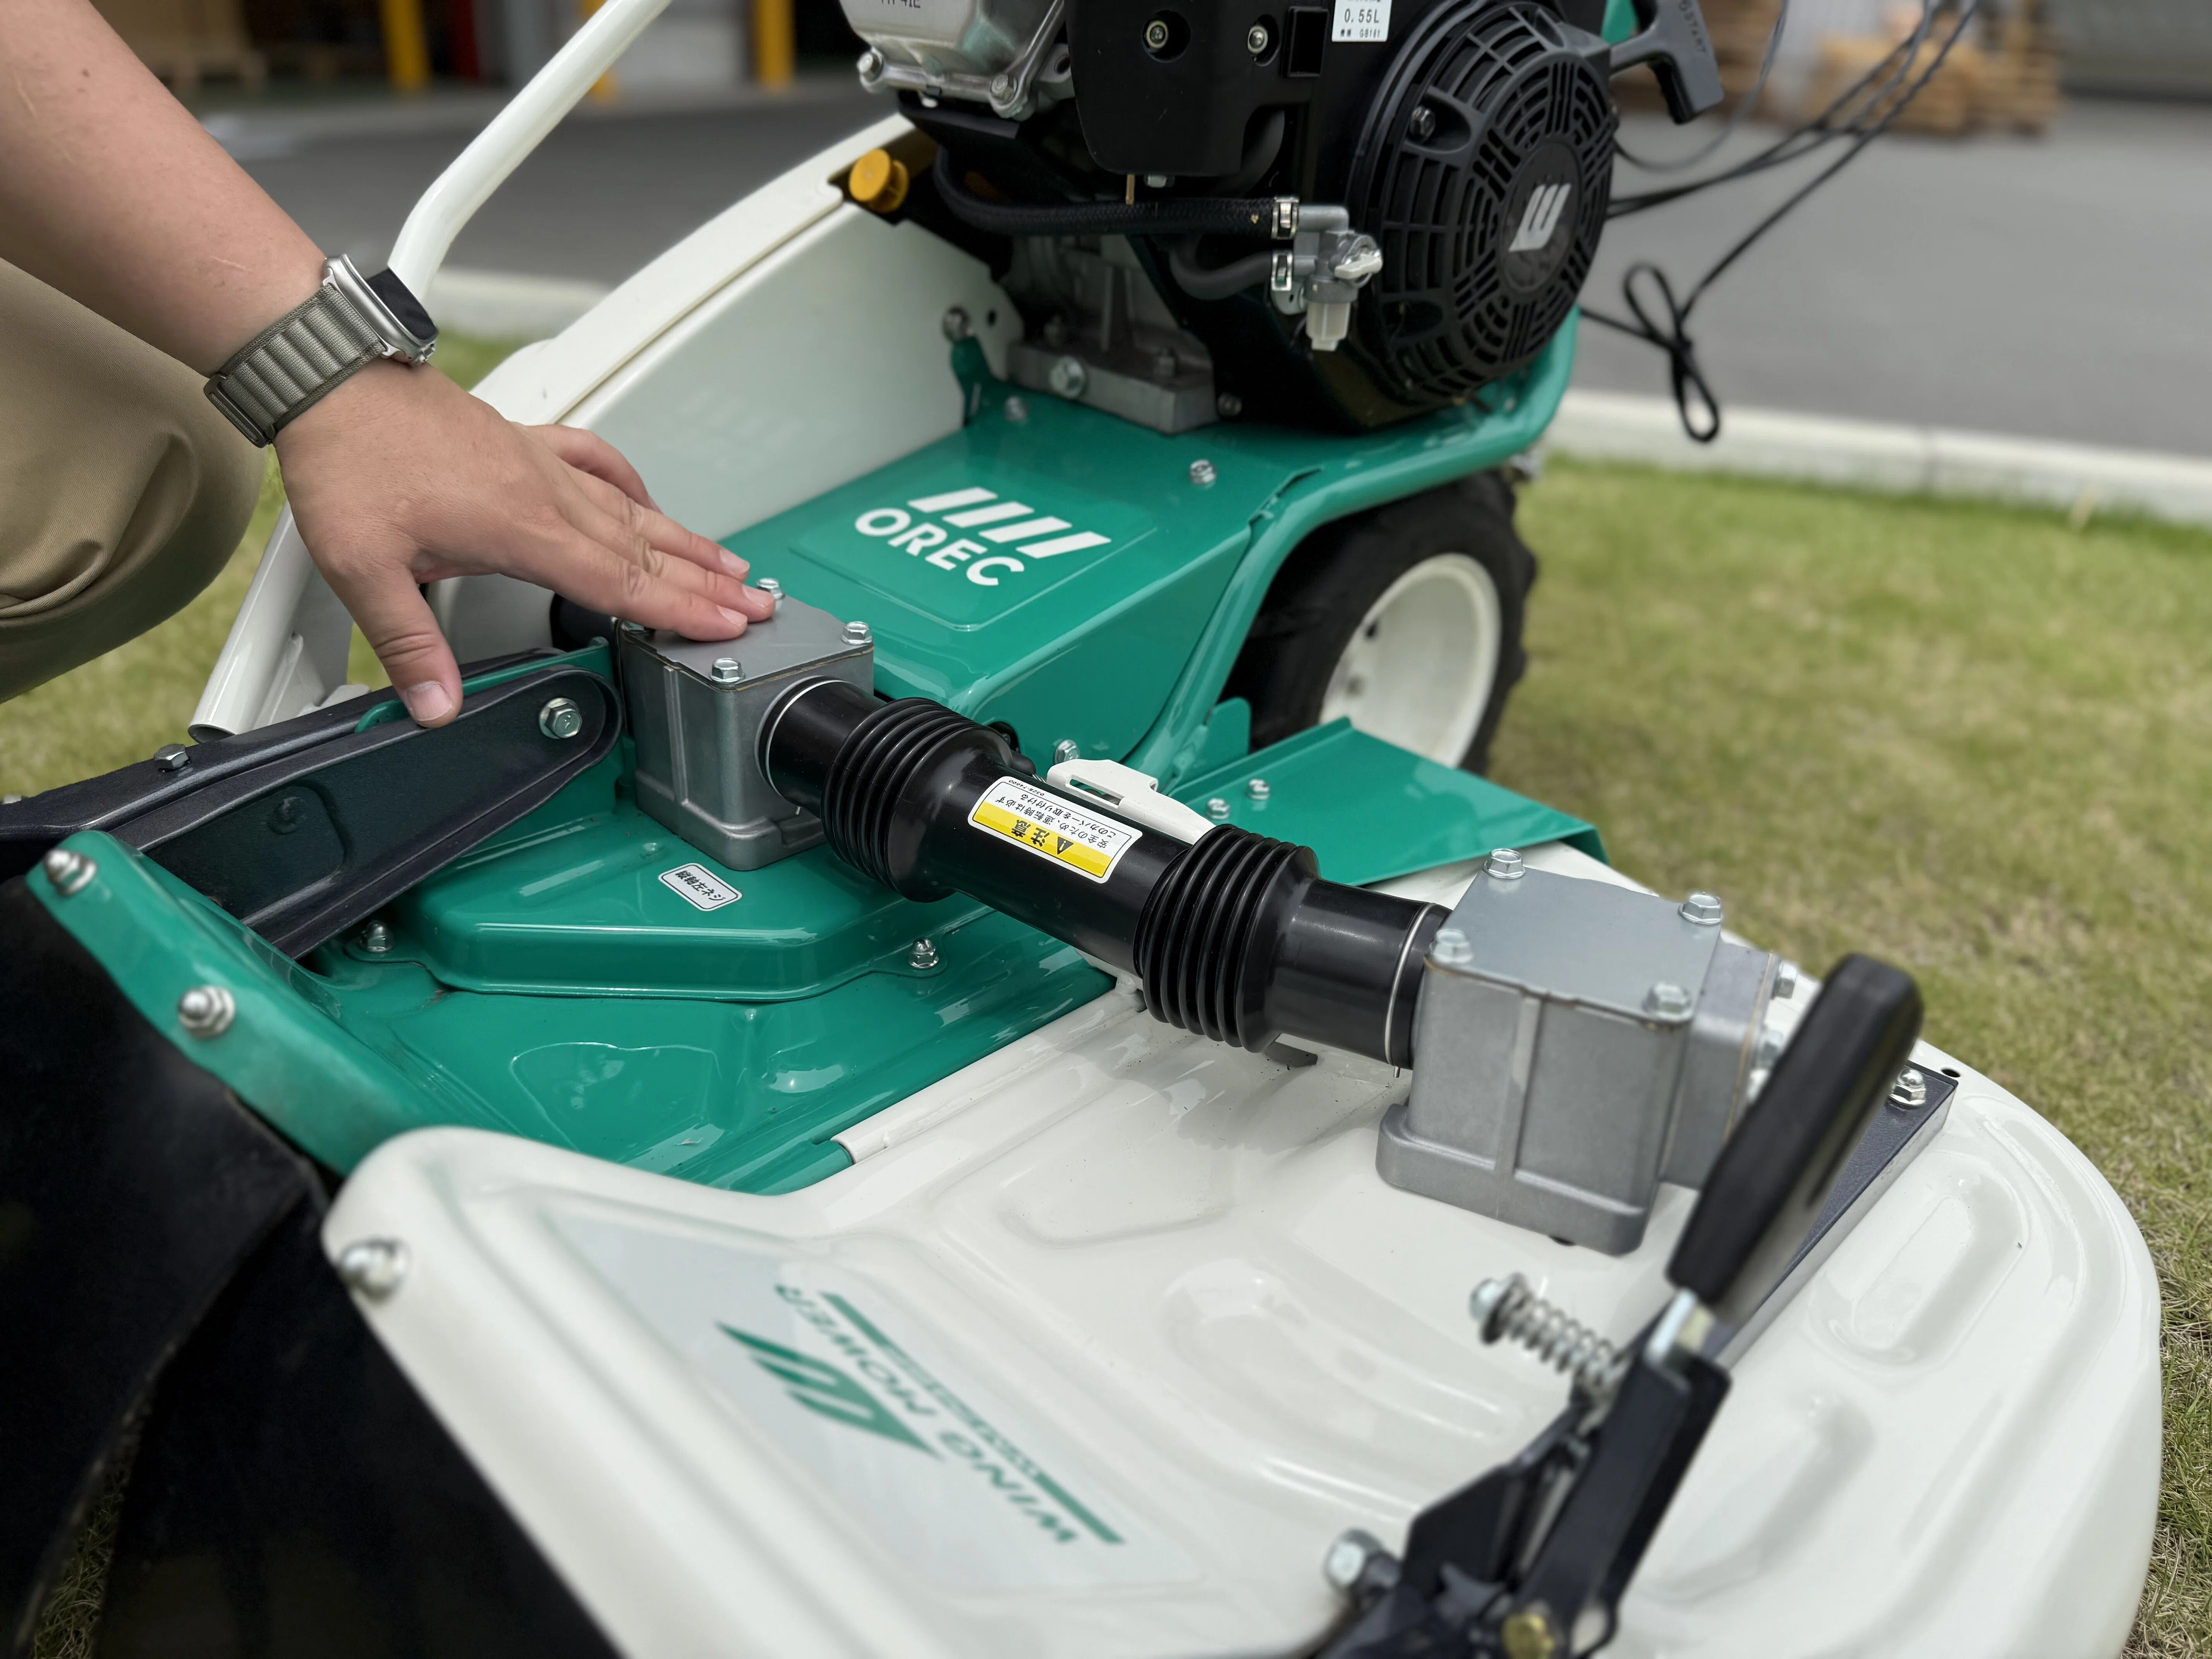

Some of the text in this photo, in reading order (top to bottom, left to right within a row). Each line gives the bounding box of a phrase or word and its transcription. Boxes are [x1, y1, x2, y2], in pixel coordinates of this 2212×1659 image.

[855, 508, 1024, 586] OREC
[1011, 819, 1050, 847] 注意
[1020, 794, 1116, 838] このカバーを取り付ける
[775, 1283, 938, 1417] MOWER
[938, 1431, 1079, 1543] WING
